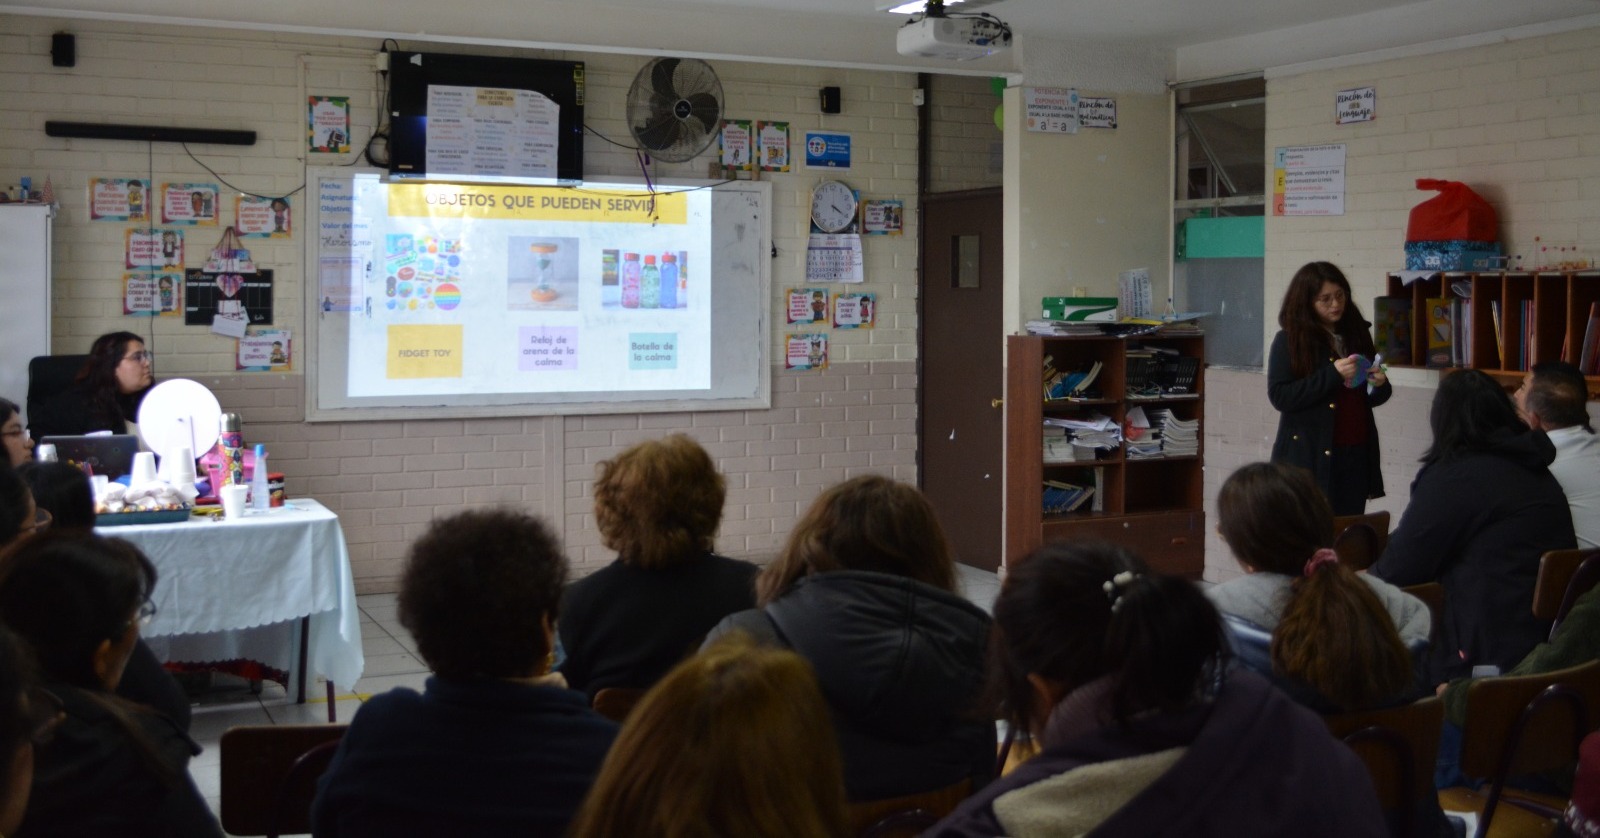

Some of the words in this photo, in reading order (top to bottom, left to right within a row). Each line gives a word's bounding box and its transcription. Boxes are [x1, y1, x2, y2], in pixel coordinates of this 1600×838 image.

[1338, 90, 1362, 103] Rincón
[1079, 100, 1104, 108] Rincón
[1279, 153, 1284, 162] T
[1278, 177, 1283, 186] E
[425, 193, 496, 207] OBJETOS
[502, 195, 534, 210] QUE
[542, 196, 601, 210] PUEDEN
[1278, 204, 1283, 213] C
[531, 336, 551, 346] Reloj
[552, 336, 567, 344] de
[523, 347, 549, 356] arena
[552, 346, 563, 355] de
[566, 346, 574, 355] la
[632, 342, 660, 351] Botella
[662, 342, 674, 351] de
[398, 350, 430, 358] FIDGET
[434, 349, 451, 358] TOY
[634, 352, 642, 361] la
[645, 352, 672, 362] calma
[535, 357, 563, 366] calma
